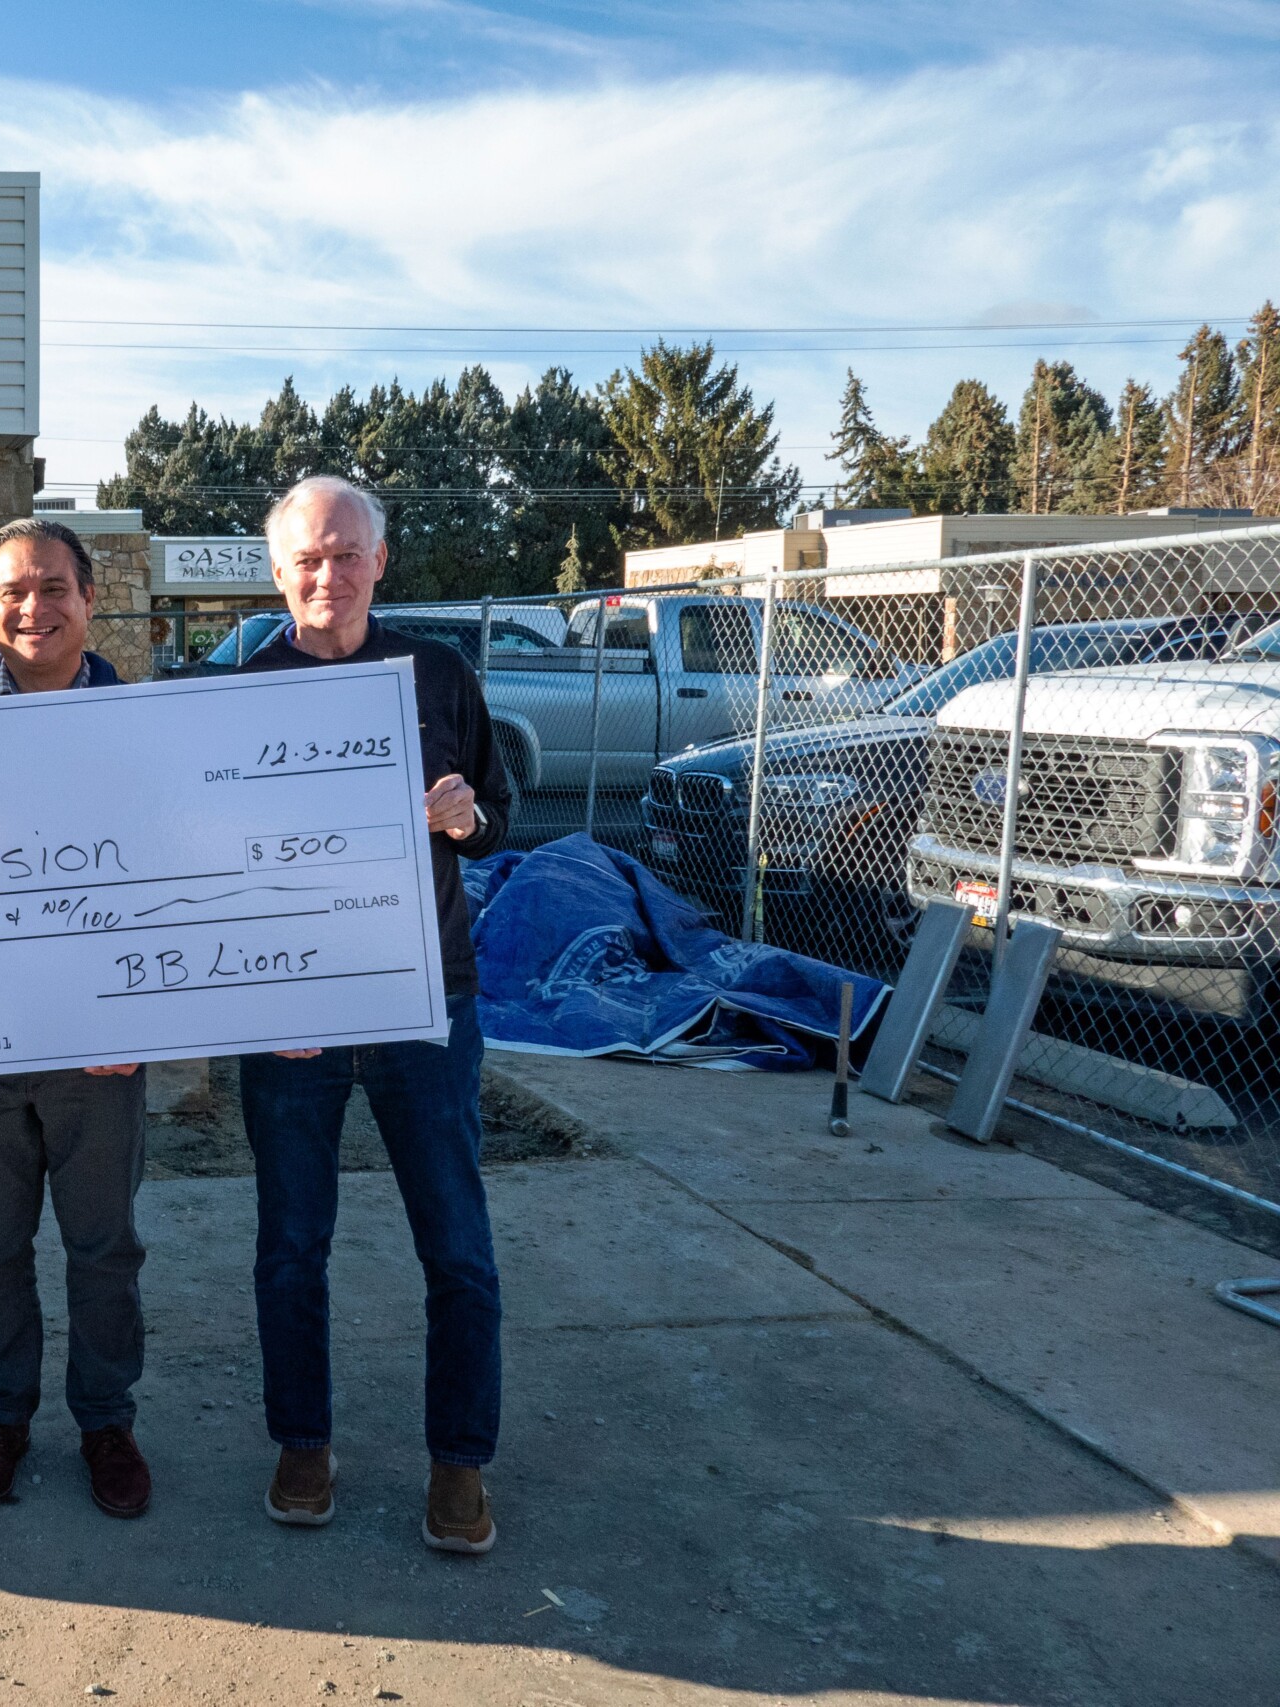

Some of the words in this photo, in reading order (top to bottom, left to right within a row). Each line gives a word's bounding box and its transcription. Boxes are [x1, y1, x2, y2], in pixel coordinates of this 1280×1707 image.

[182, 567, 258, 578] MASSAGE
[204, 769, 241, 782] DATE
[251, 843, 263, 861] $
[275, 834, 347, 862] 500
[334, 895, 399, 911] DOLLARS
[208, 942, 317, 977] Lions
[565, 940, 602, 978] RENTA
